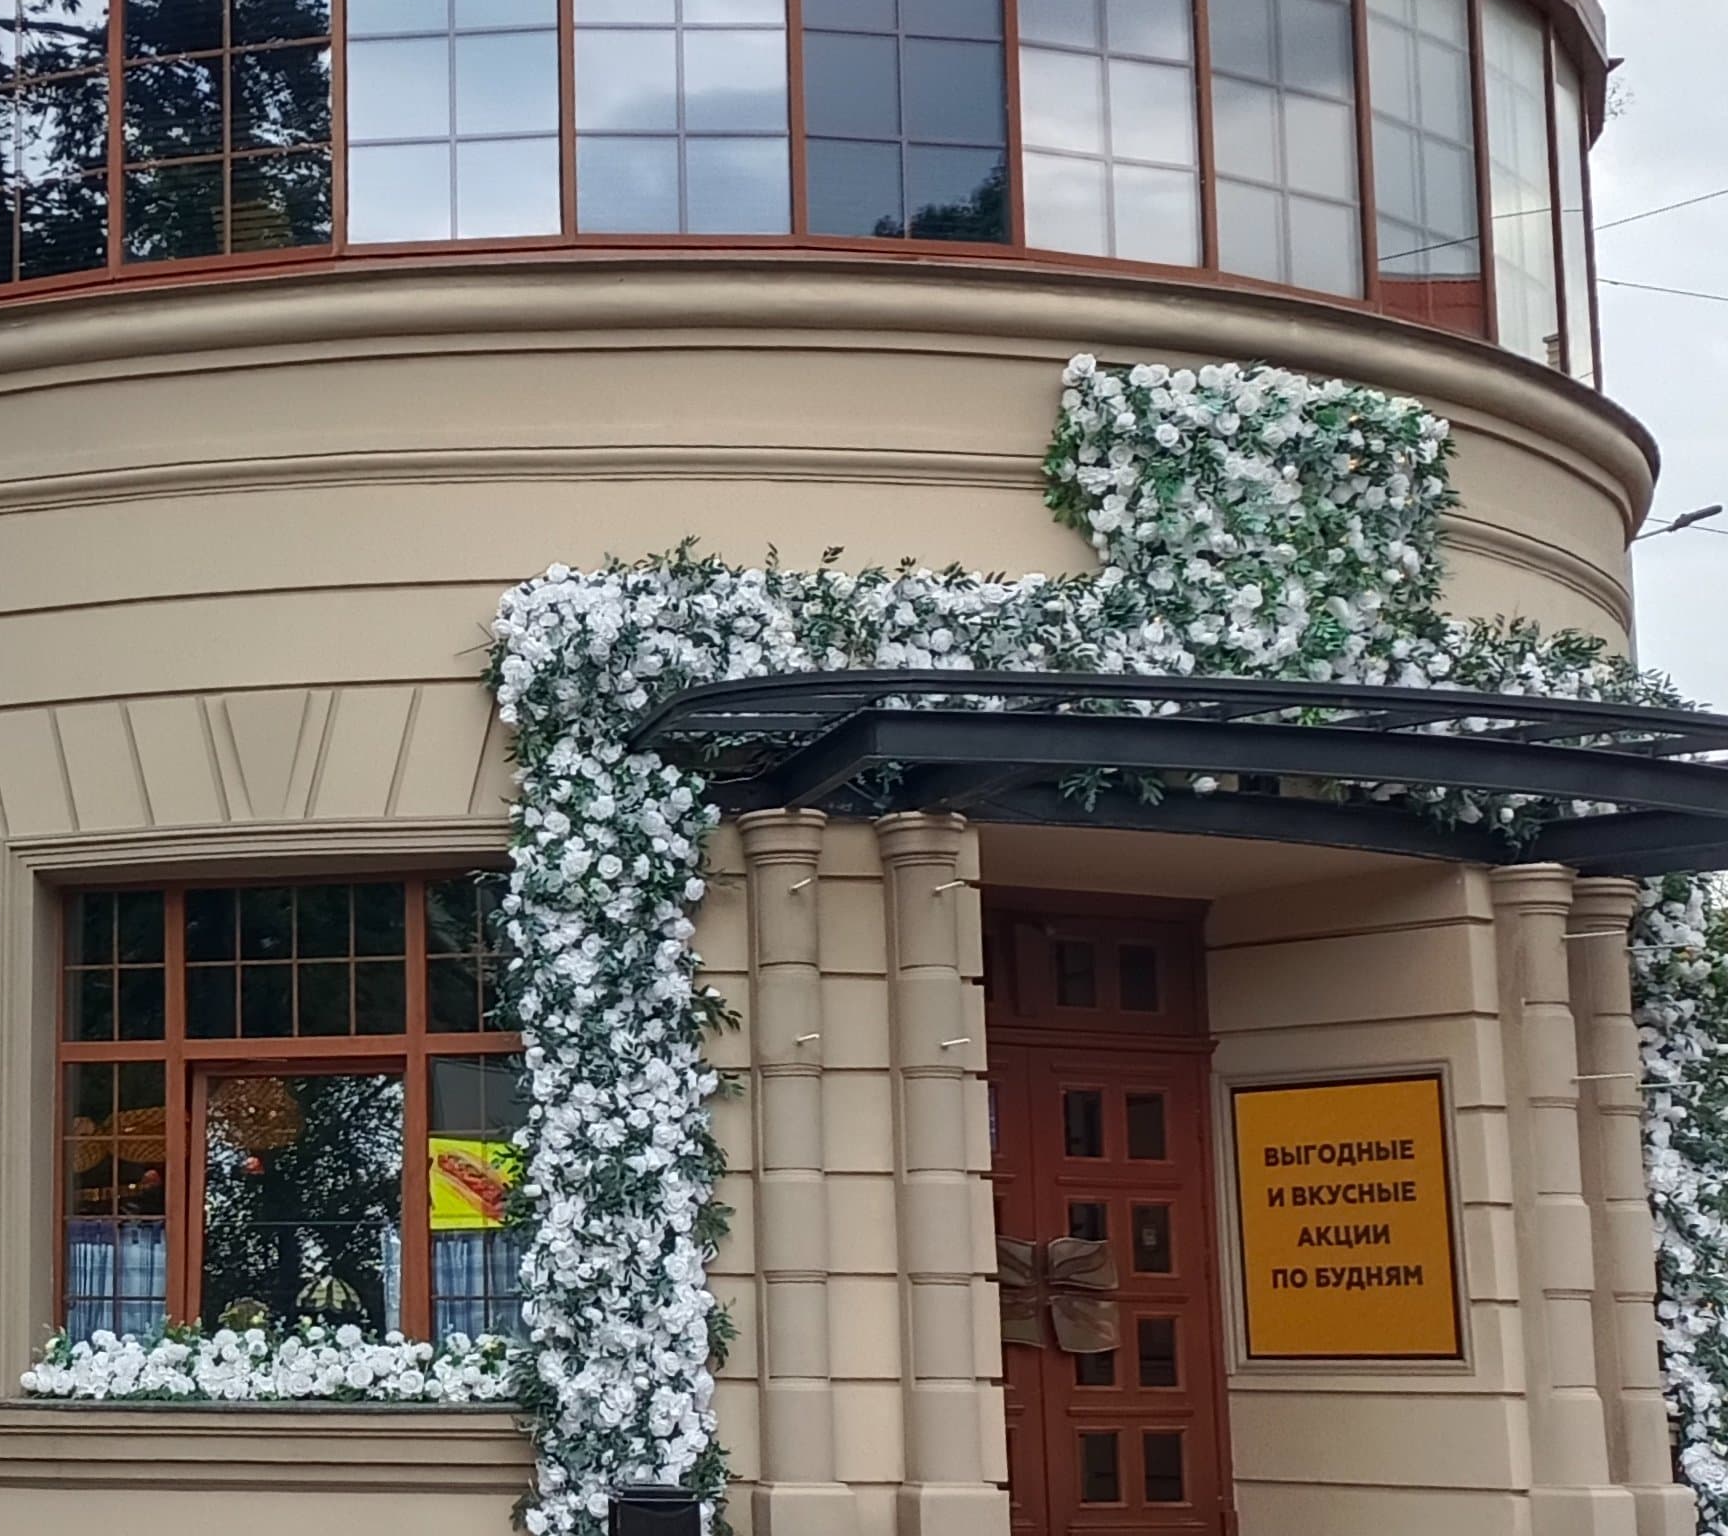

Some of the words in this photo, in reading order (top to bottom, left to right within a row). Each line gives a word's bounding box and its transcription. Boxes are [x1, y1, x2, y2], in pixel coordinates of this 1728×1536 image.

[1264, 1139, 1415, 1167] ВЫГОДНЫЕ
[1267, 1187, 1284, 1208] И
[1292, 1181, 1416, 1207] ВКУСНЫЕ
[1298, 1224, 1391, 1249] АКЦИИ
[1272, 1268, 1308, 1289] ПО
[1315, 1265, 1423, 1291] БУДНЯМ
